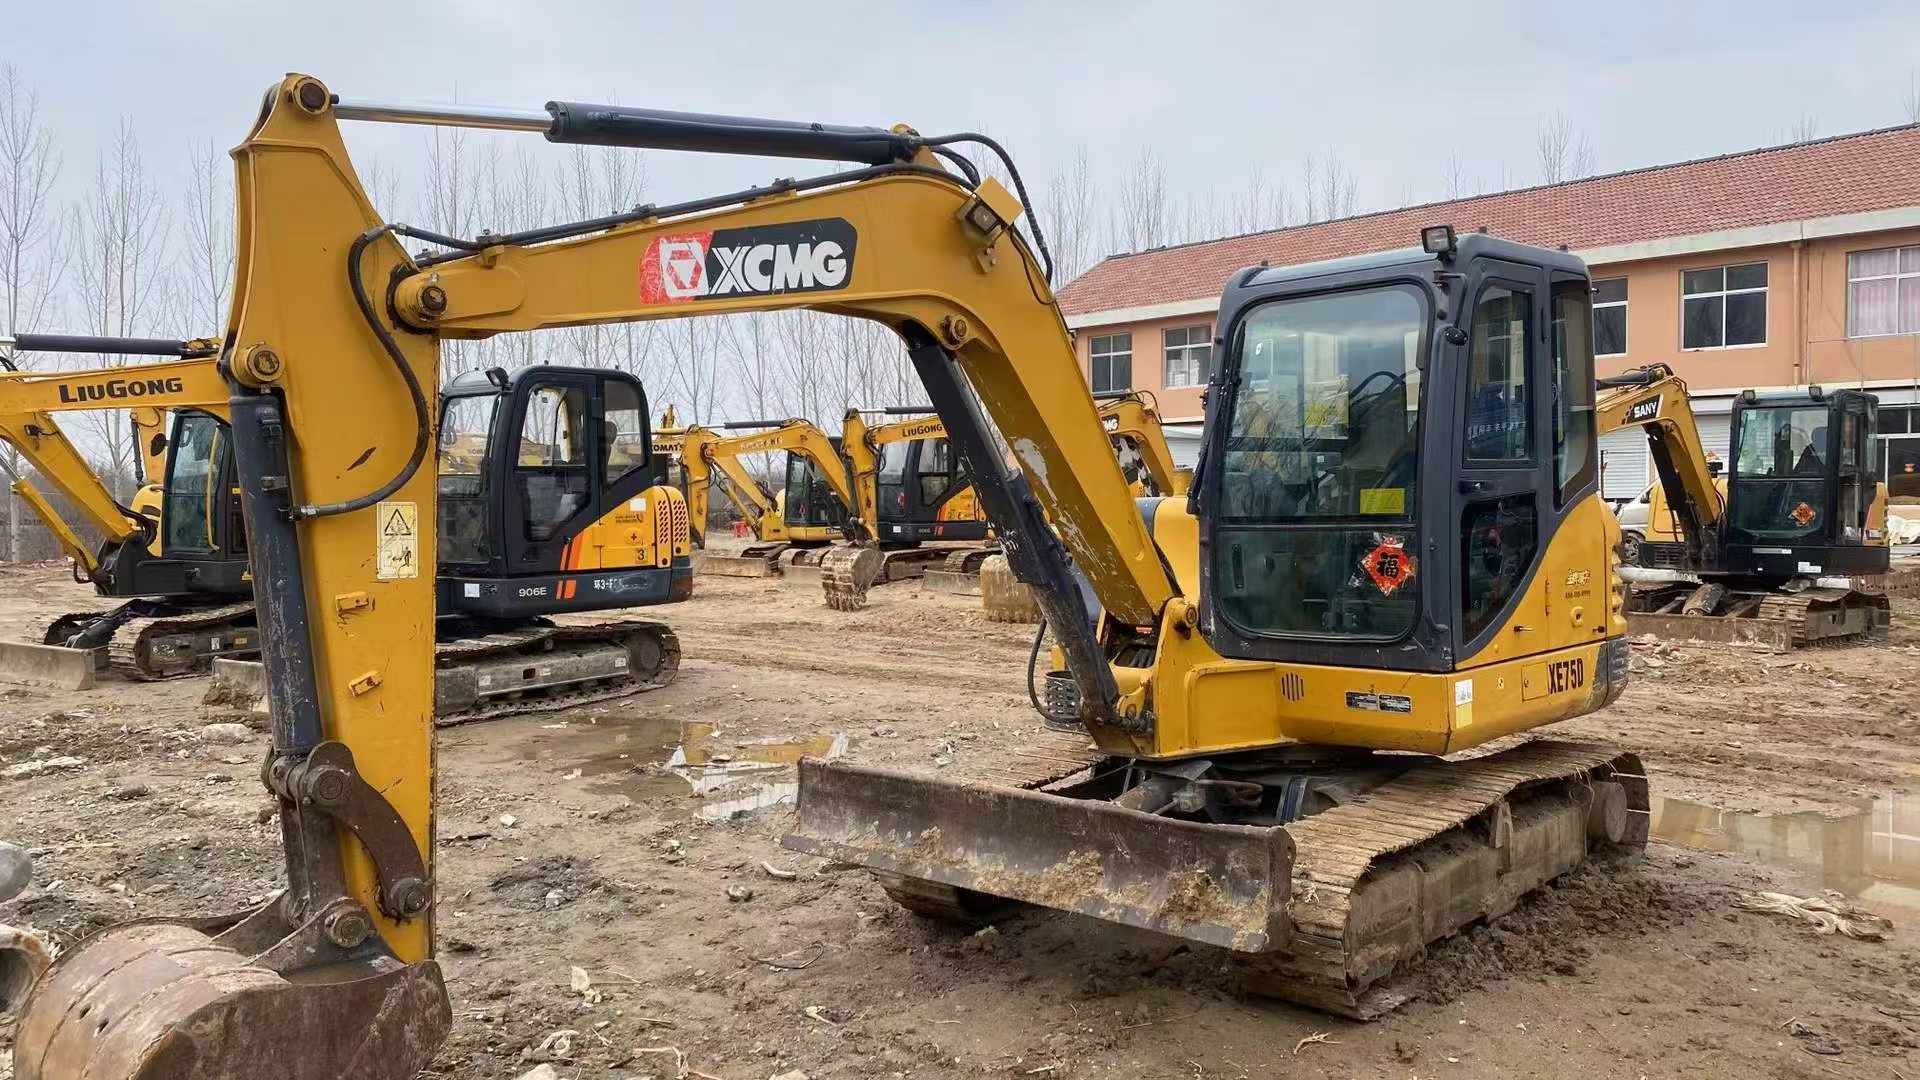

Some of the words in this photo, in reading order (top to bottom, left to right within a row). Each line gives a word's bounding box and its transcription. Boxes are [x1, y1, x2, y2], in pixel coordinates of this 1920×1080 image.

[709, 240, 847, 295] XCMG
[1634, 402, 1658, 418] SANY
[638, 549, 646, 560] 3
[1376, 552, 1400, 578] 福
[518, 586, 547, 597] 906E
[1548, 658, 1584, 694] XE75D
